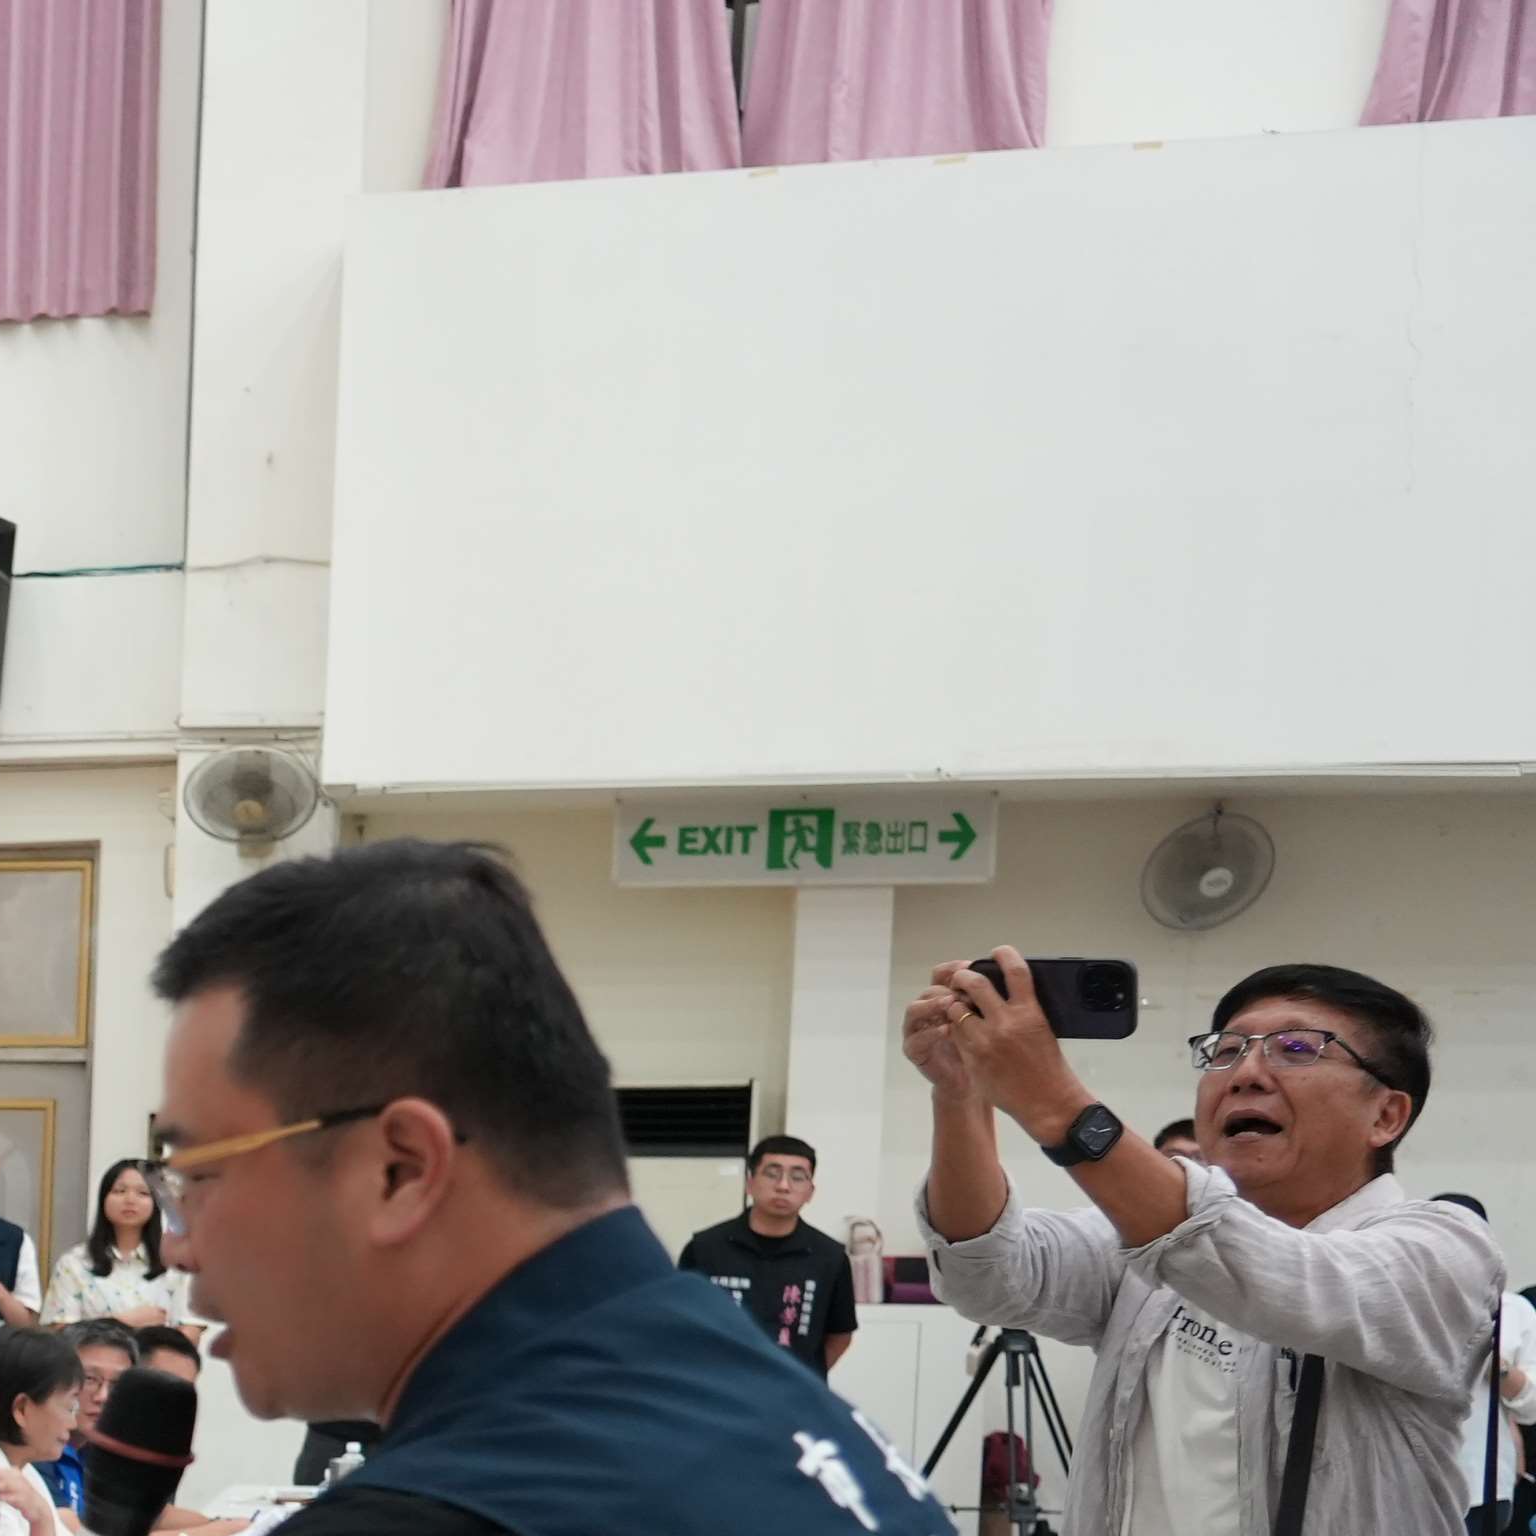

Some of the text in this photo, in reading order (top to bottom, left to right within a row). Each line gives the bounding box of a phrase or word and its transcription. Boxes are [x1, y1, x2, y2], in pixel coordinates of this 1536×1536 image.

[677, 825, 758, 856] EXIT
[841, 820, 928, 855] 緊急出口
